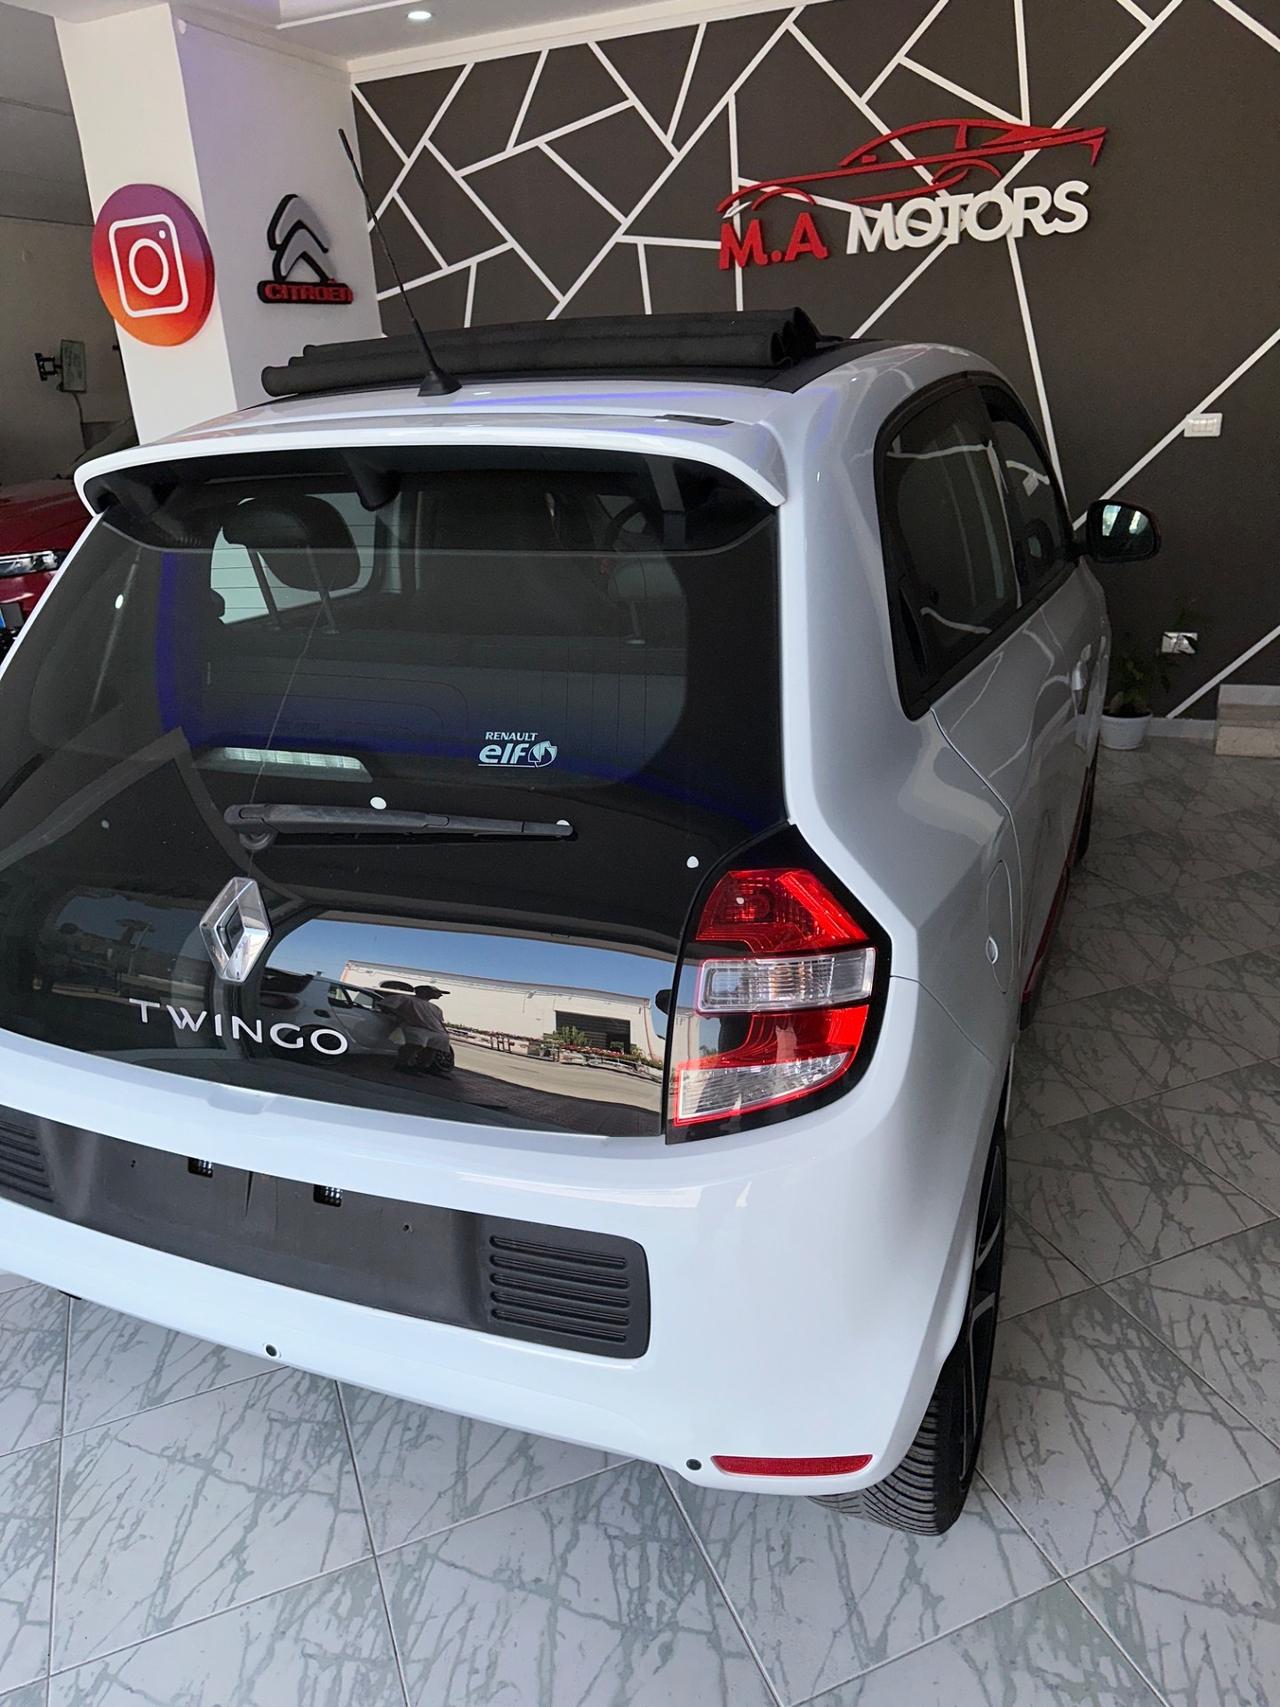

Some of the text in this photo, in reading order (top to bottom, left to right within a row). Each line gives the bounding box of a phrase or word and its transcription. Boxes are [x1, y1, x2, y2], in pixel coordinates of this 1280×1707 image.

[719, 180, 1090, 270] M.A MOTORS
[478, 743, 530, 764] elf
[484, 731, 539, 741] RENAULT
[129, 998, 349, 1056] TWINGO
